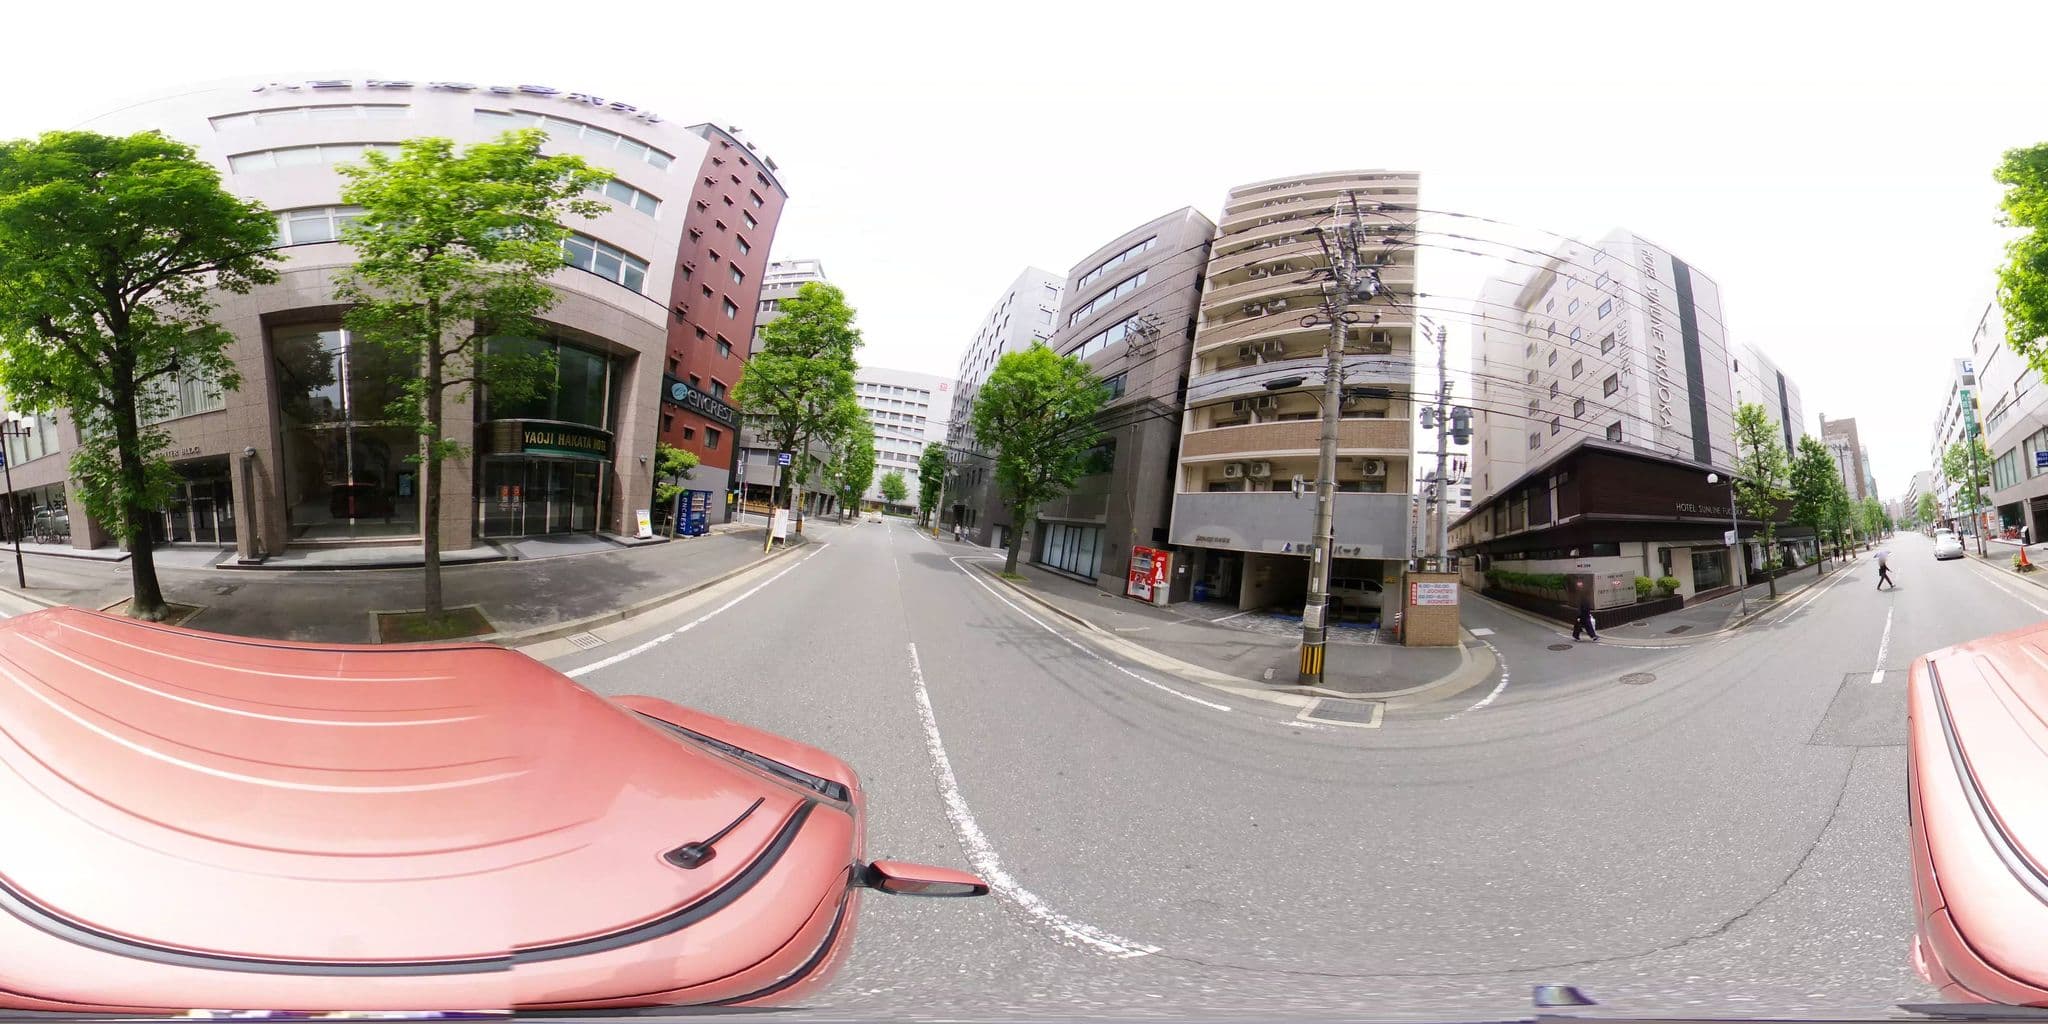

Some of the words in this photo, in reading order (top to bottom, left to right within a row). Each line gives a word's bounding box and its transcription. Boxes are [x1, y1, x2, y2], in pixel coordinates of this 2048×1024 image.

[1641, 249, 1656, 279] HOTEL
[1646, 283, 1665, 341] SUNLINE
[1653, 344, 1673, 428] FUKUOKA
[525, 431, 554, 445] YAOJI
[558, 433, 592, 449] HAKATA
[1676, 502, 1696, 513] HOTEL
